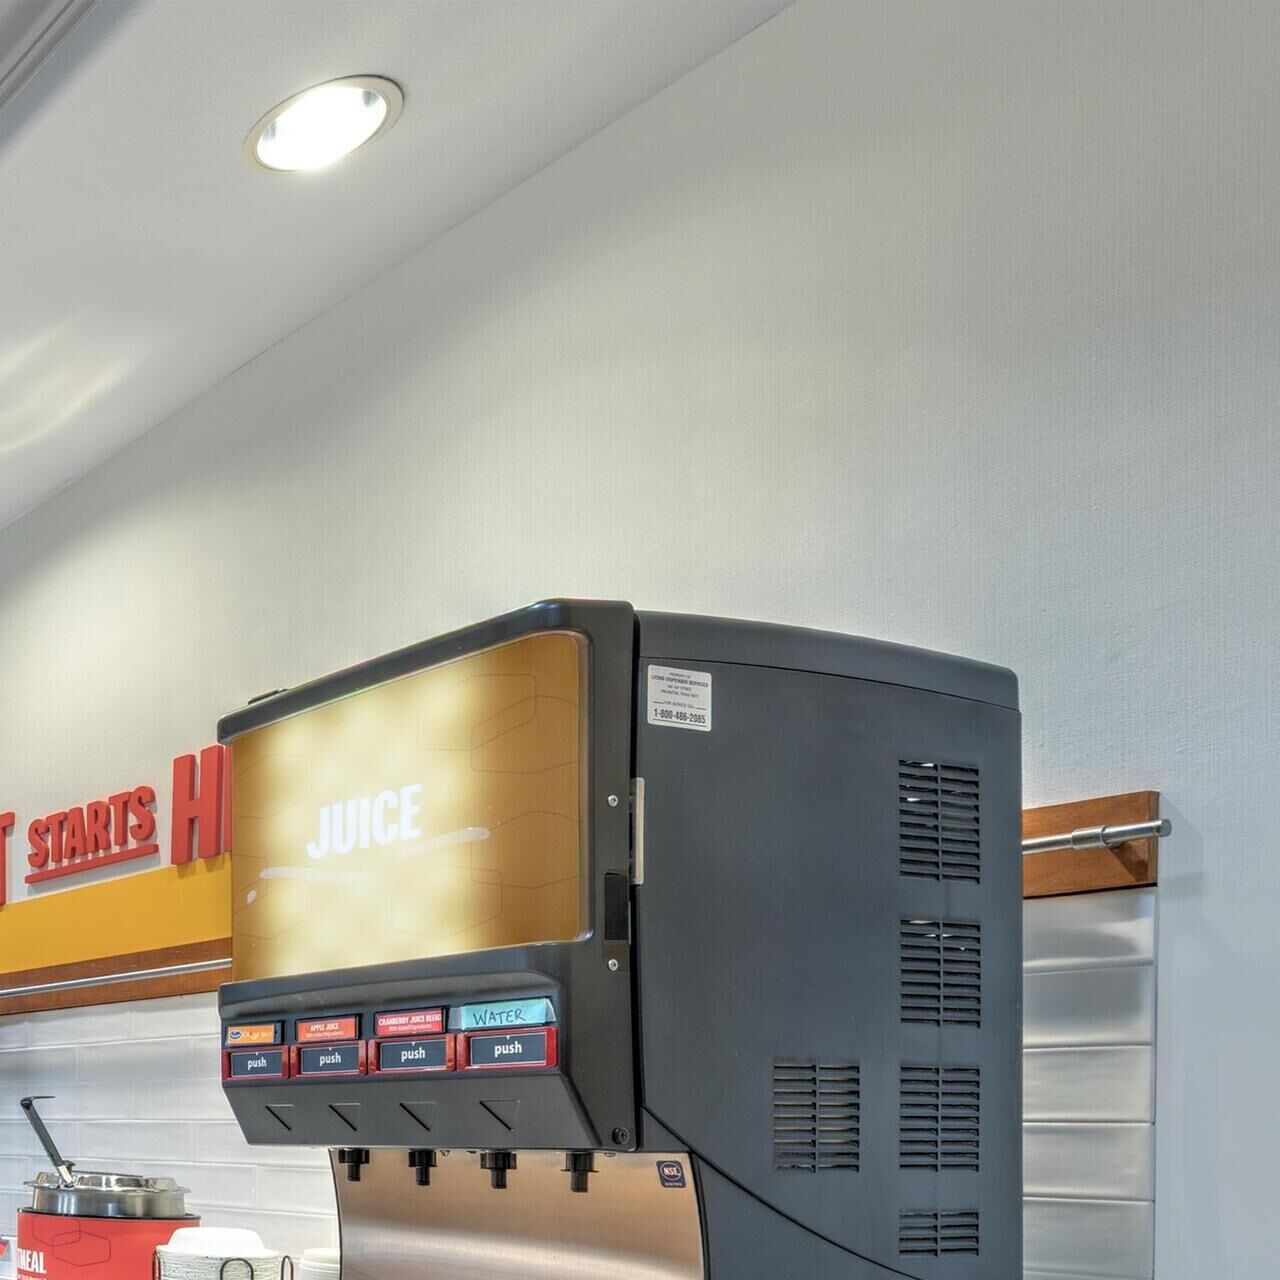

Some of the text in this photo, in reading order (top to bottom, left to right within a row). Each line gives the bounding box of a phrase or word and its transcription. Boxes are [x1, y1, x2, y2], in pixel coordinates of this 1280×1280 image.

[26, 785, 156, 869] STARTS
[171, 744, 232, 865] H
[305, 783, 422, 860] JUICE
[378, 1016, 409, 1026] CRANBERRY
[410, 1014, 425, 1024] JUICE
[473, 1008, 527, 1026] WATER
[310, 1022, 339, 1032] APPLE JUICE
[401, 1047, 426, 1062] push
[494, 1041, 523, 1058] push
[247, 1056, 267, 1070] push
[319, 1052, 342, 1067] push
